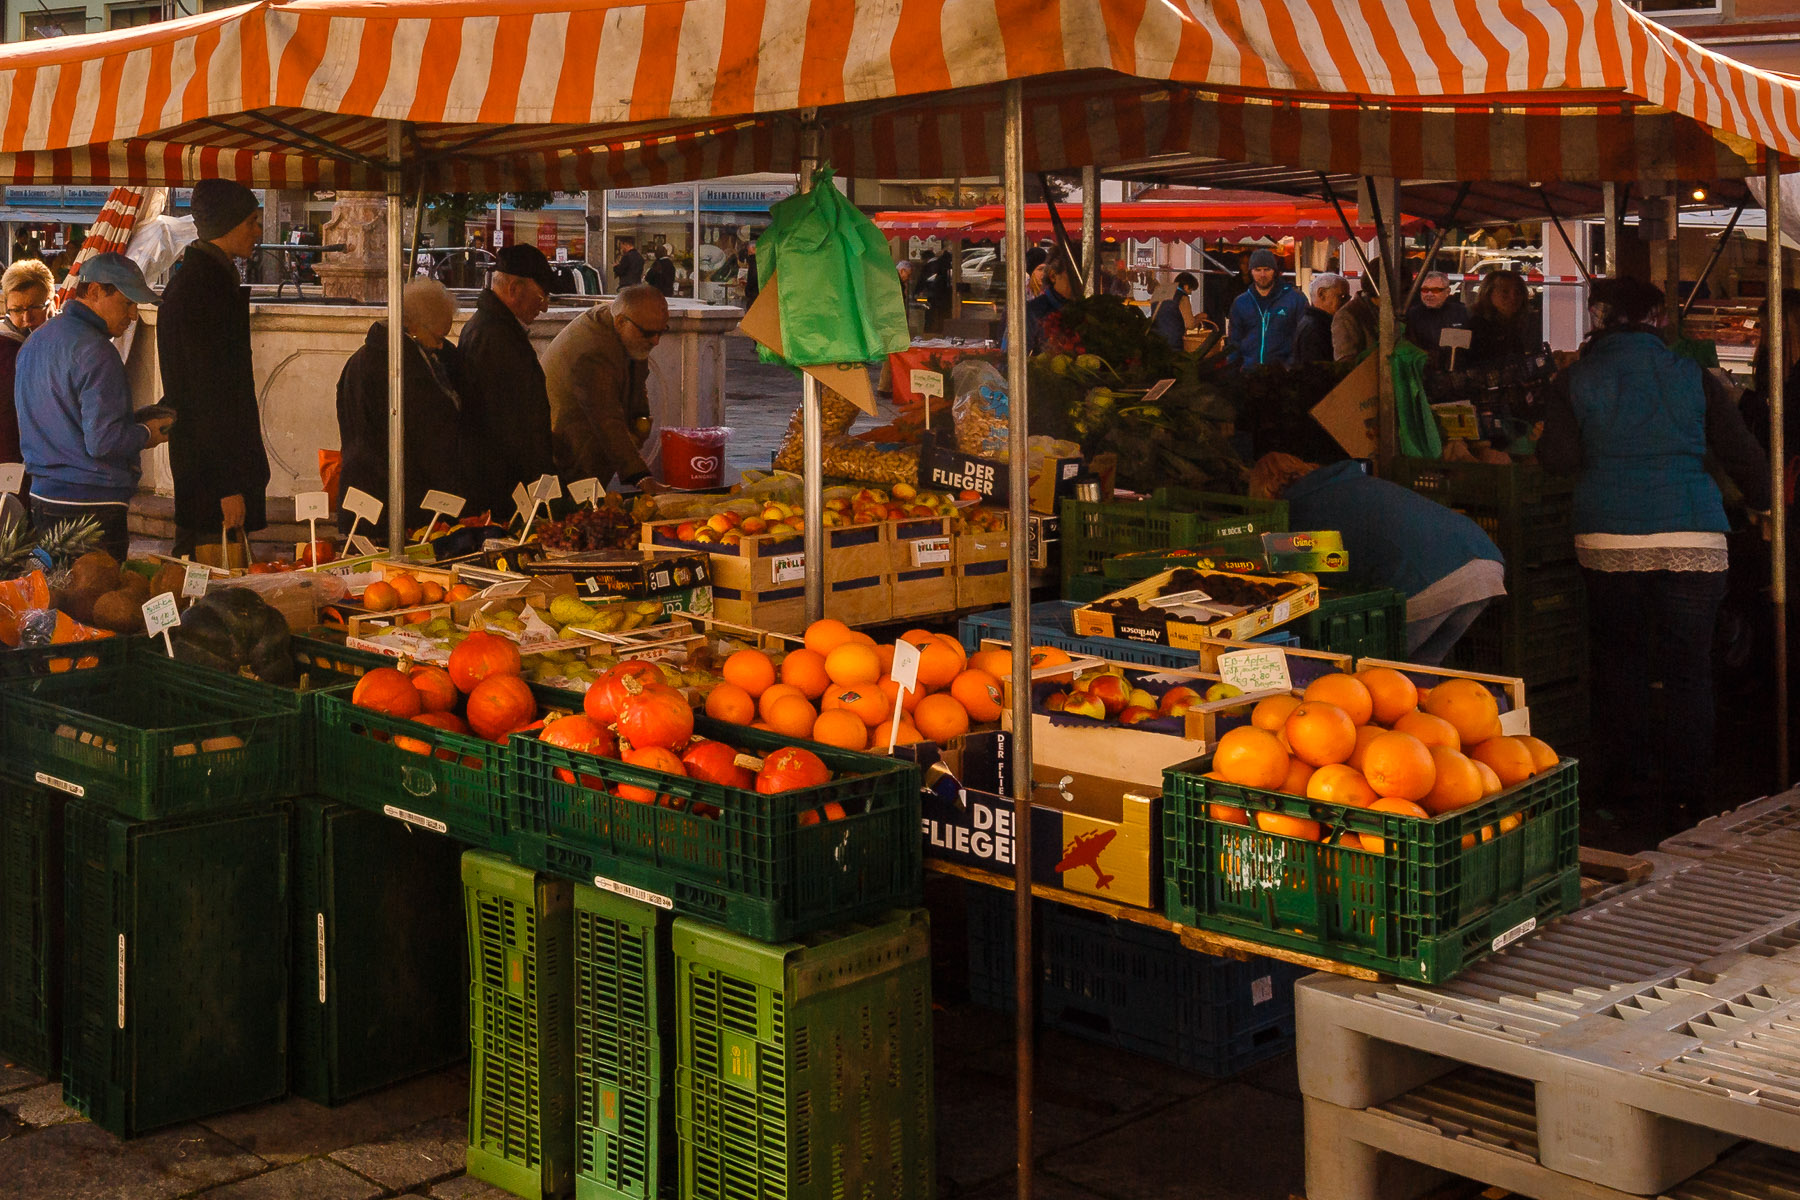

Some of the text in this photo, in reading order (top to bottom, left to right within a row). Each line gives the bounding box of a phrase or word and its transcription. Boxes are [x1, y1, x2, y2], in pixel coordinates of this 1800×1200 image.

[932, 468, 994, 496] FLIEGER
[964, 461, 995, 482] DER
[997, 734, 1005, 759] DER
